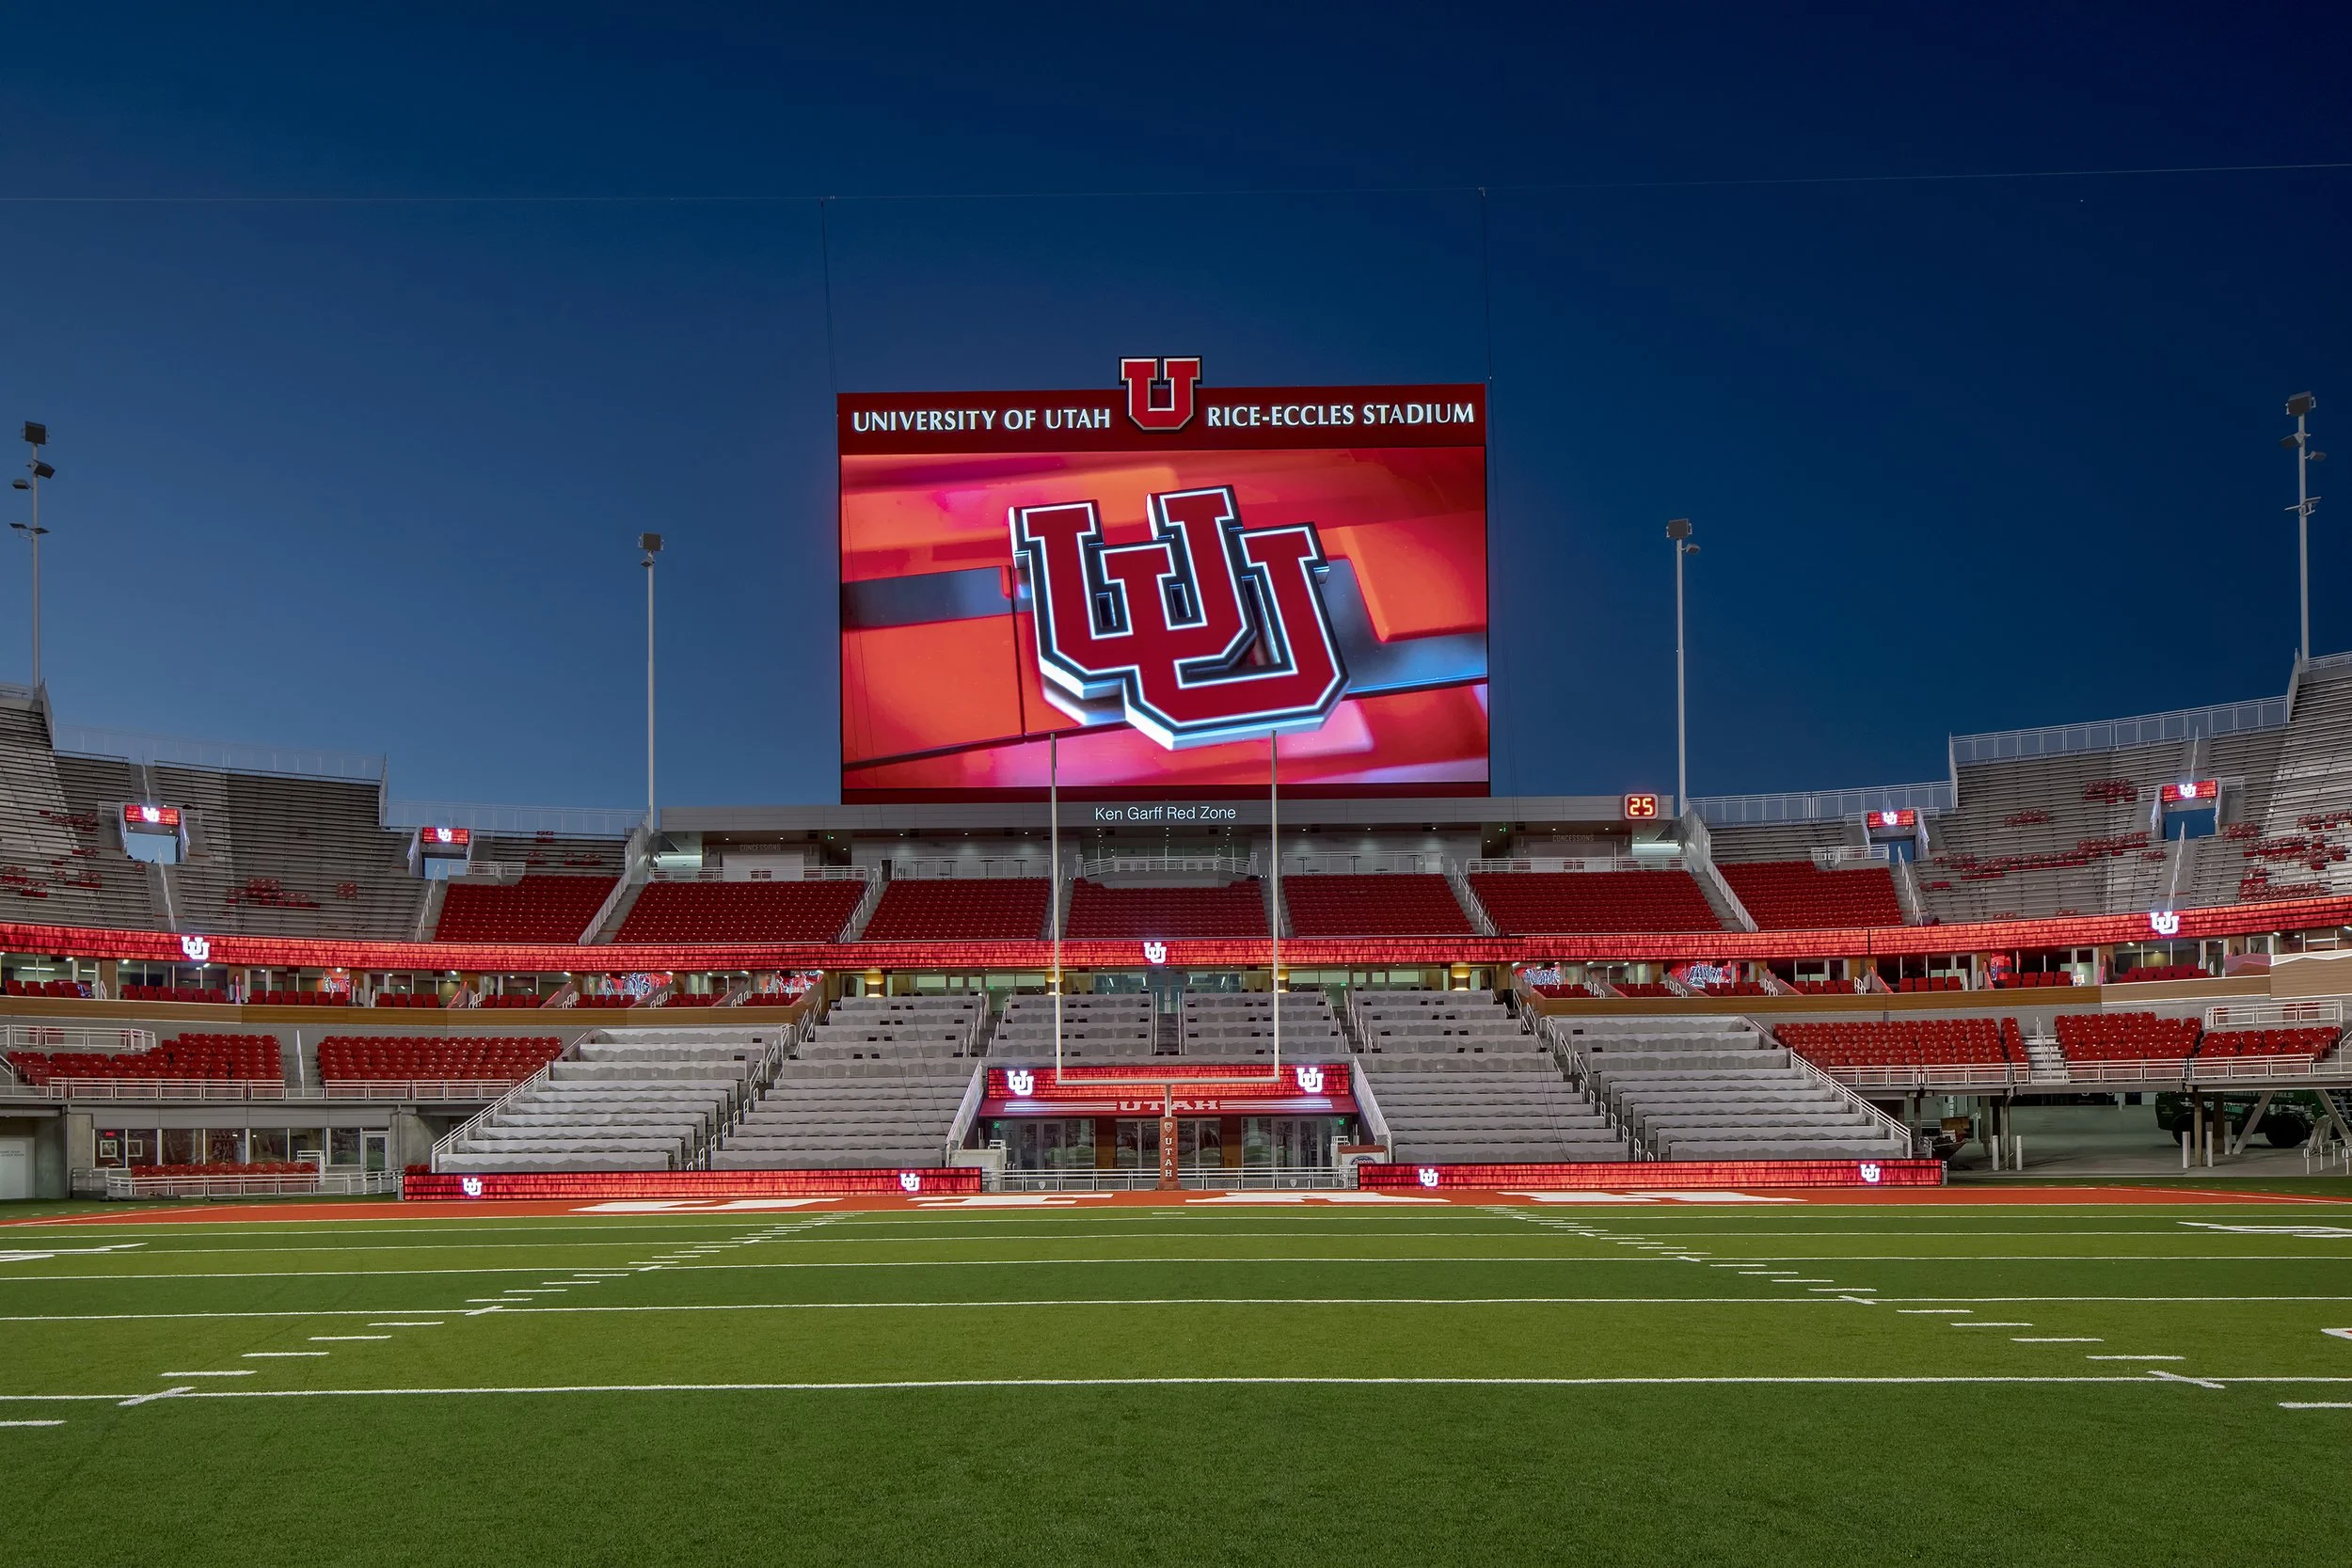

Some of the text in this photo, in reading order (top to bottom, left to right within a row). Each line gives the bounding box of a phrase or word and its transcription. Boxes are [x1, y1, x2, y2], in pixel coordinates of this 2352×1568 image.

[1118, 356, 1202, 434] U
[853, 408, 1111, 432] UNIVERSITY OF UTAH
[1207, 404, 1474, 427] RICE-ECCLES STADIUM
[1095, 806, 1236, 820] Ken Garff Red Zone
[1629, 797, 1653, 816] 25
[1552, 834, 1595, 843] CONCESSIONS
[1119, 1100, 1218, 1111] UTAH
[1164, 1137, 1173, 1178] UTAH
